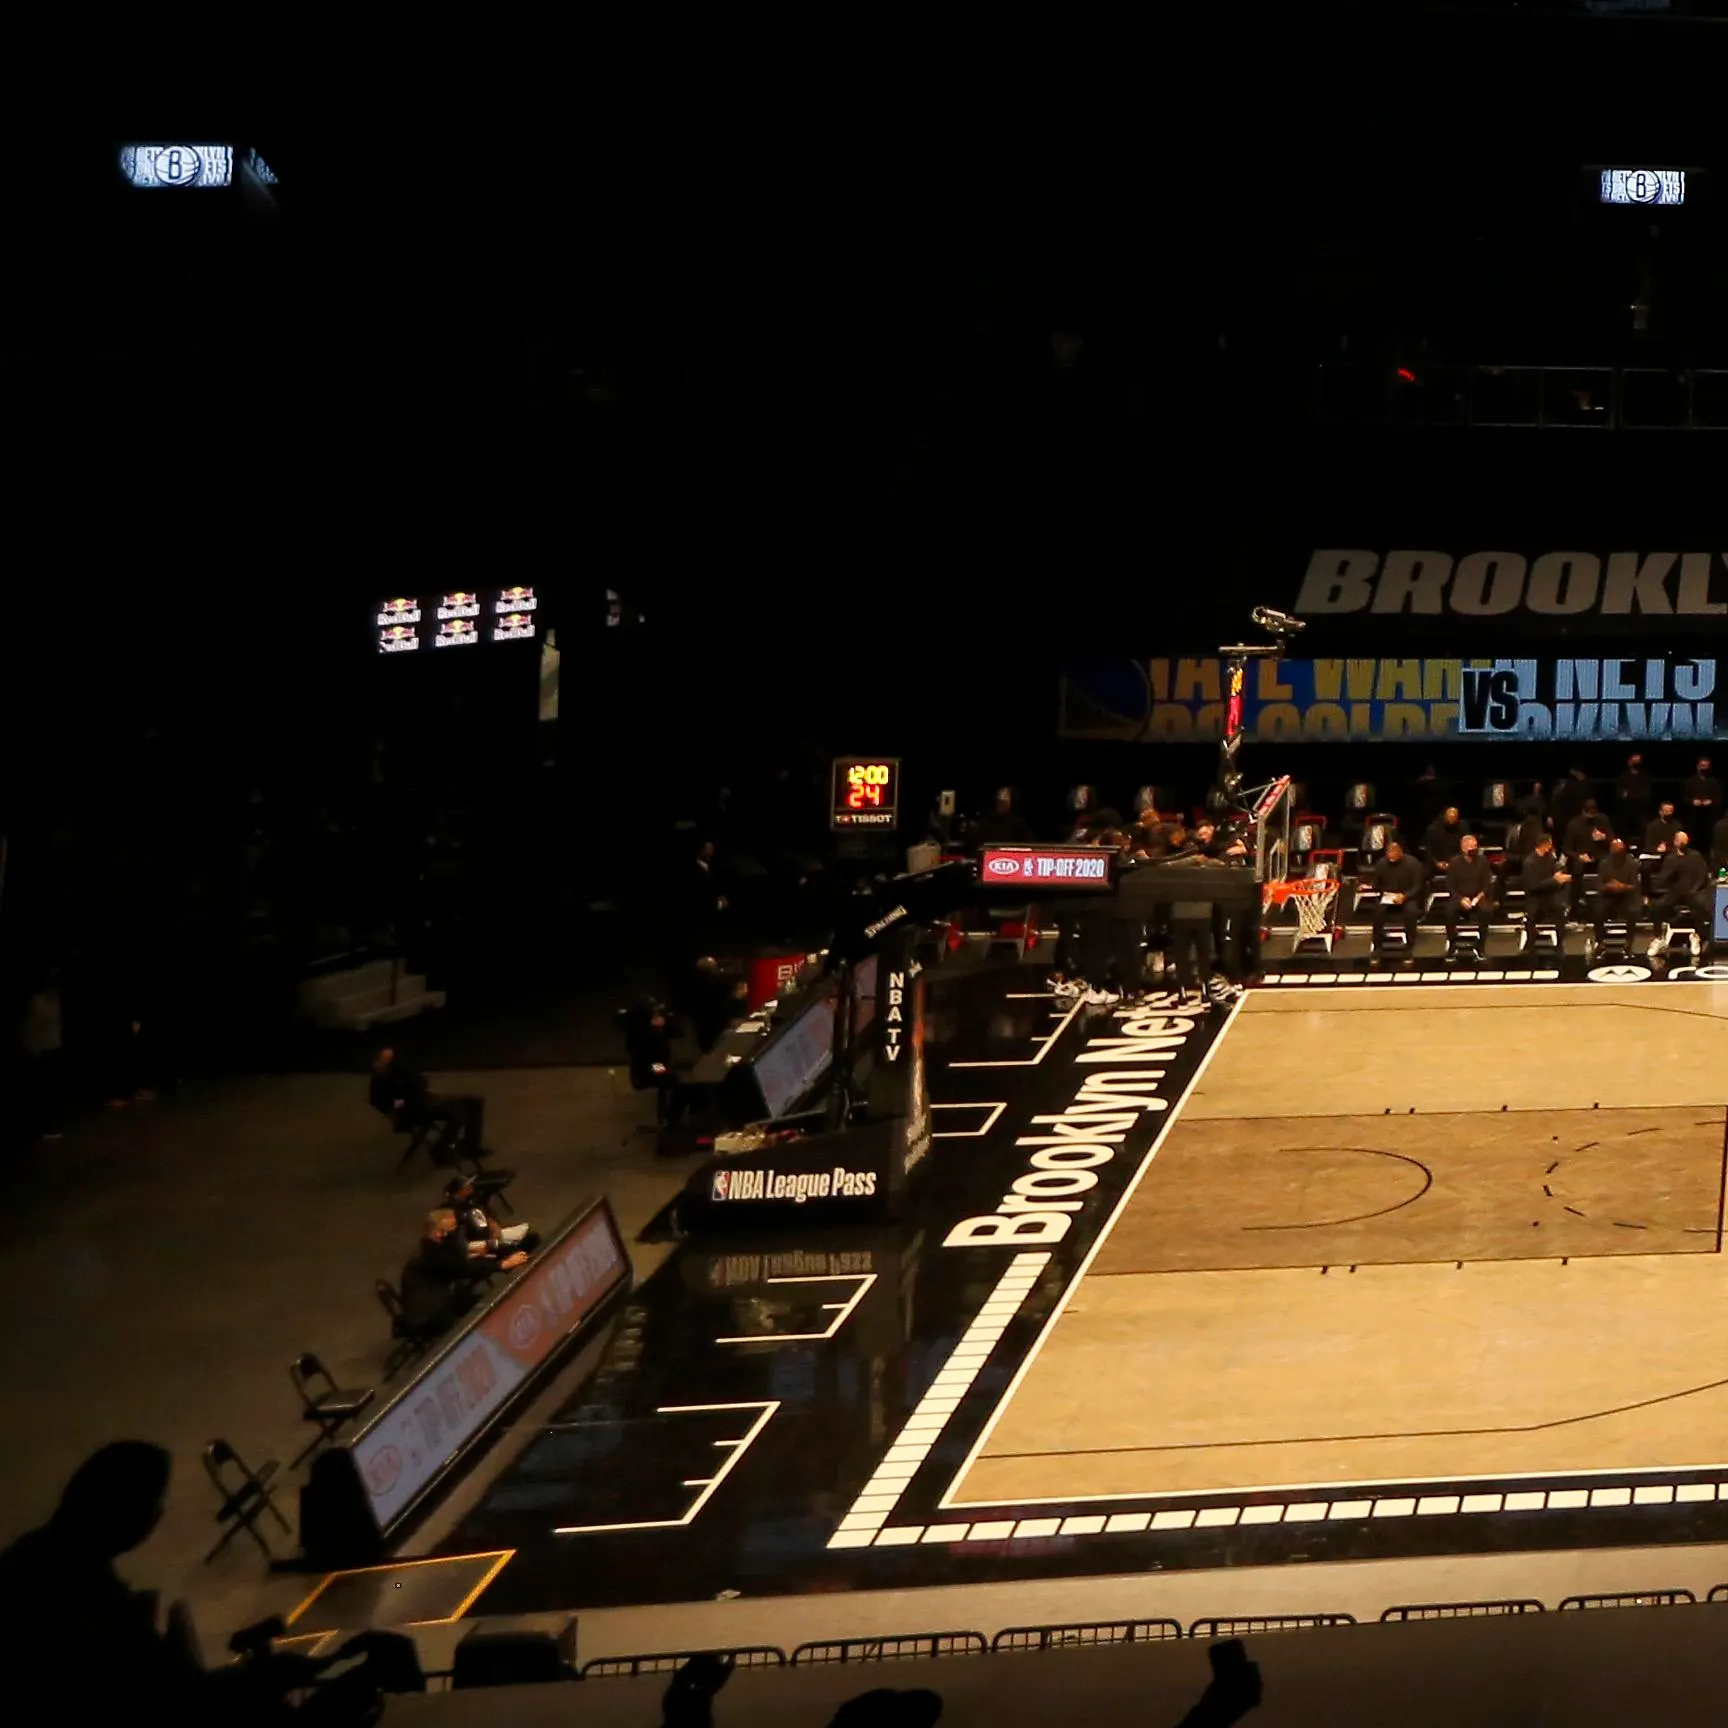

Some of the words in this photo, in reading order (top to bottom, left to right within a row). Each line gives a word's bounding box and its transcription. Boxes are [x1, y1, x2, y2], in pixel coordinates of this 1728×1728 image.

[1463, 671, 1519, 729] VS
[849, 784, 881, 808] 24
[851, 814, 892, 824] TISSOT
[1075, 859, 1105, 878] 2020
[886, 972, 905, 1022] NBA
[885, 1029, 902, 1062] TV
[943, 1069, 1169, 1248] Brooklyn
[728, 1171, 764, 1200] NBA
[765, 1170, 832, 1203] League
[832, 1167, 876, 1197] Pass
